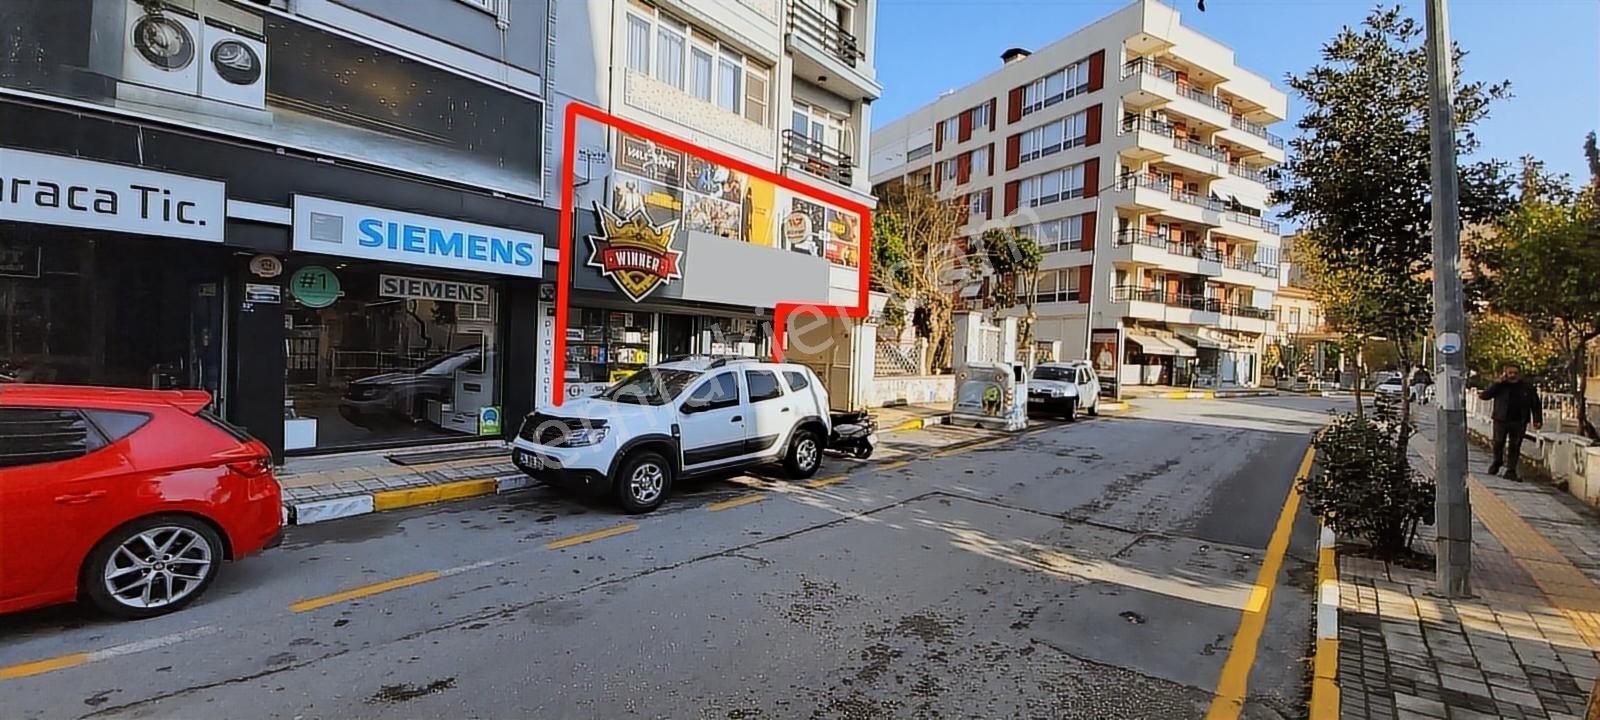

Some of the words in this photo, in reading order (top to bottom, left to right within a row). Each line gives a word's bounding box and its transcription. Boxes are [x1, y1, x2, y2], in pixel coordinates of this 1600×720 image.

[626, 145, 678, 170] VALANT
[130, 184, 207, 226] Tic.
[358, 218, 534, 267] SIEMENS
[615, 250, 661, 272] WINNER
[299, 271, 329, 290] #1
[384, 278, 484, 301] SIEMENS
